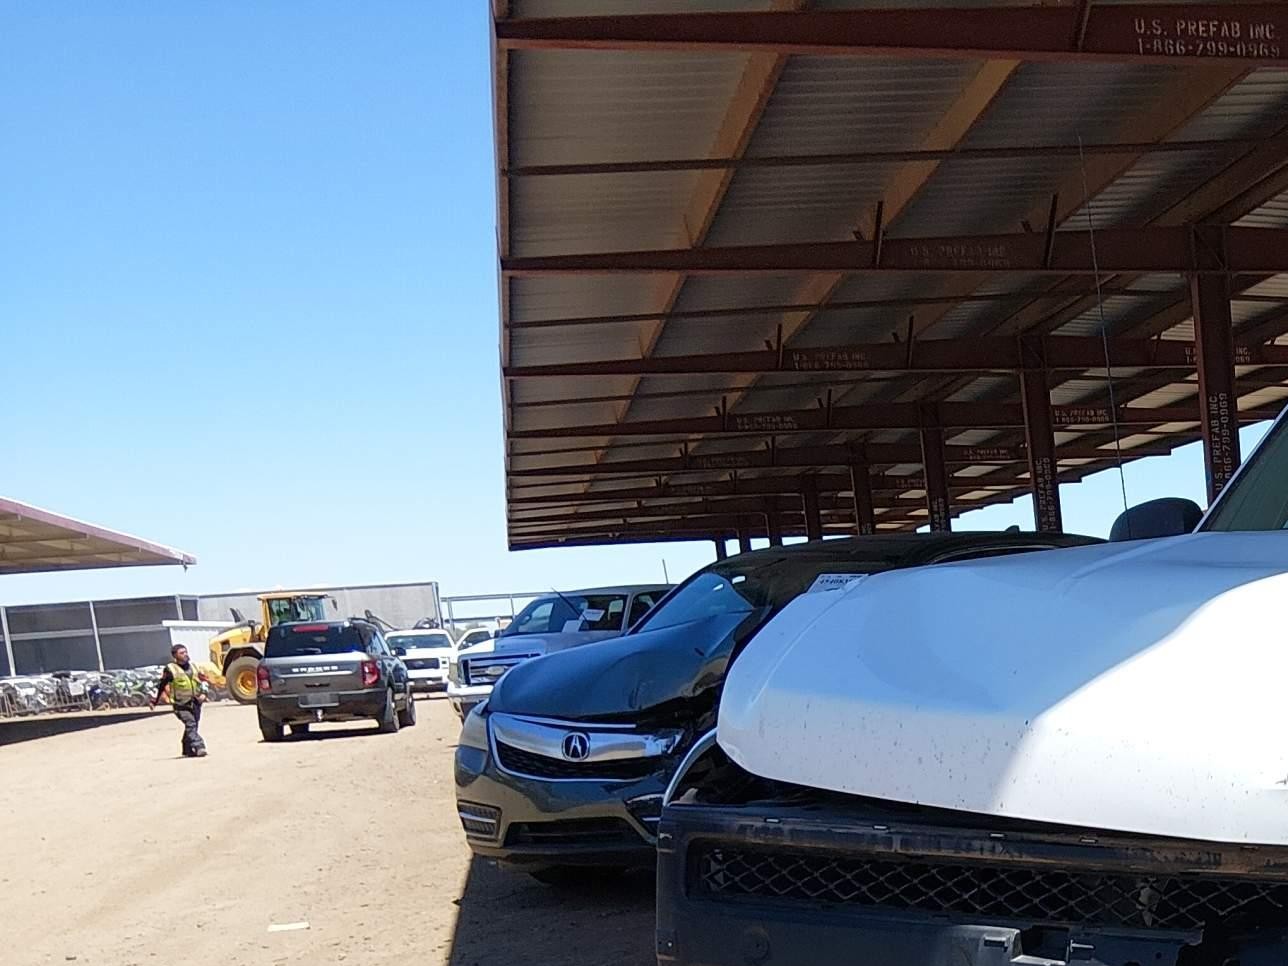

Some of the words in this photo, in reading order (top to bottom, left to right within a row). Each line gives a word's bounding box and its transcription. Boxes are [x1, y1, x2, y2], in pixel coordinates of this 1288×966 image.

[1134, 18, 1168, 36] U.S.
[1176, 19, 1241, 38] PREFAB
[1210, 420, 1222, 464] PREFAB
